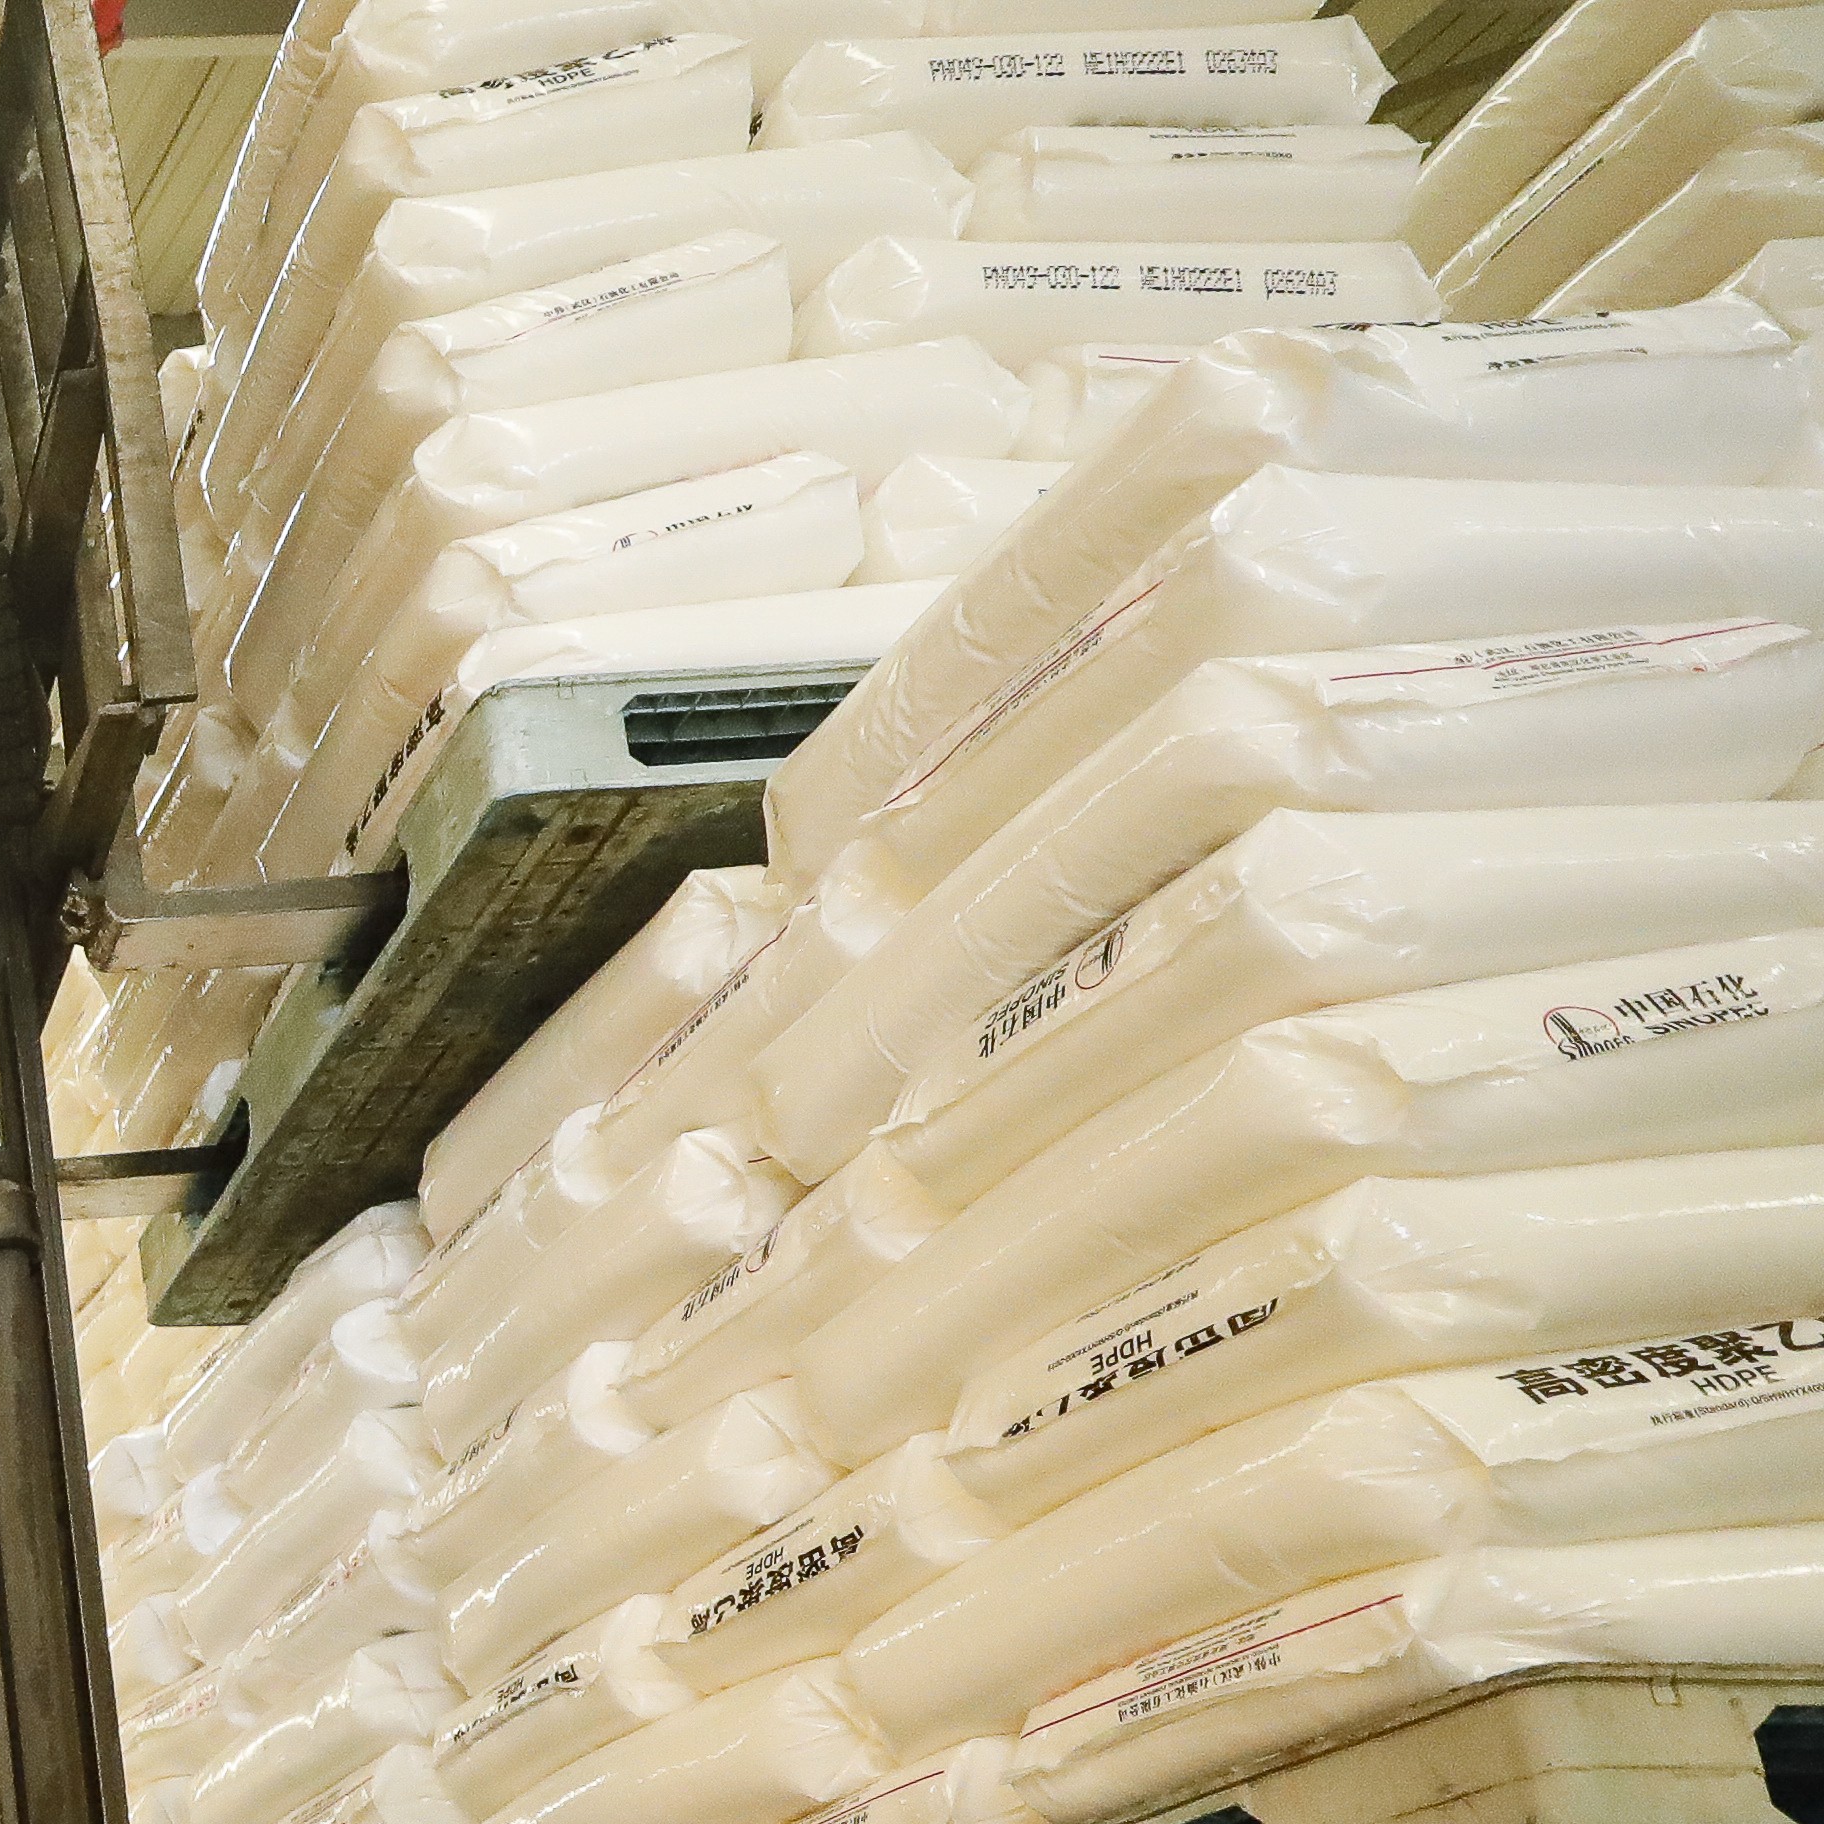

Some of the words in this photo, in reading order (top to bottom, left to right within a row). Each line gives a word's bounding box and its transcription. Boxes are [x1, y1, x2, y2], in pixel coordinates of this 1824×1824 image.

[538, 67, 595, 87] HDPE
[1614, 973, 1759, 1024] 中国石化
[978, 981, 1067, 1058] 中国石化
[1090, 1329, 1154, 1376] HDPE
[1689, 1364, 1785, 1397] HDPE
[745, 1546, 785, 1581] HDPE
